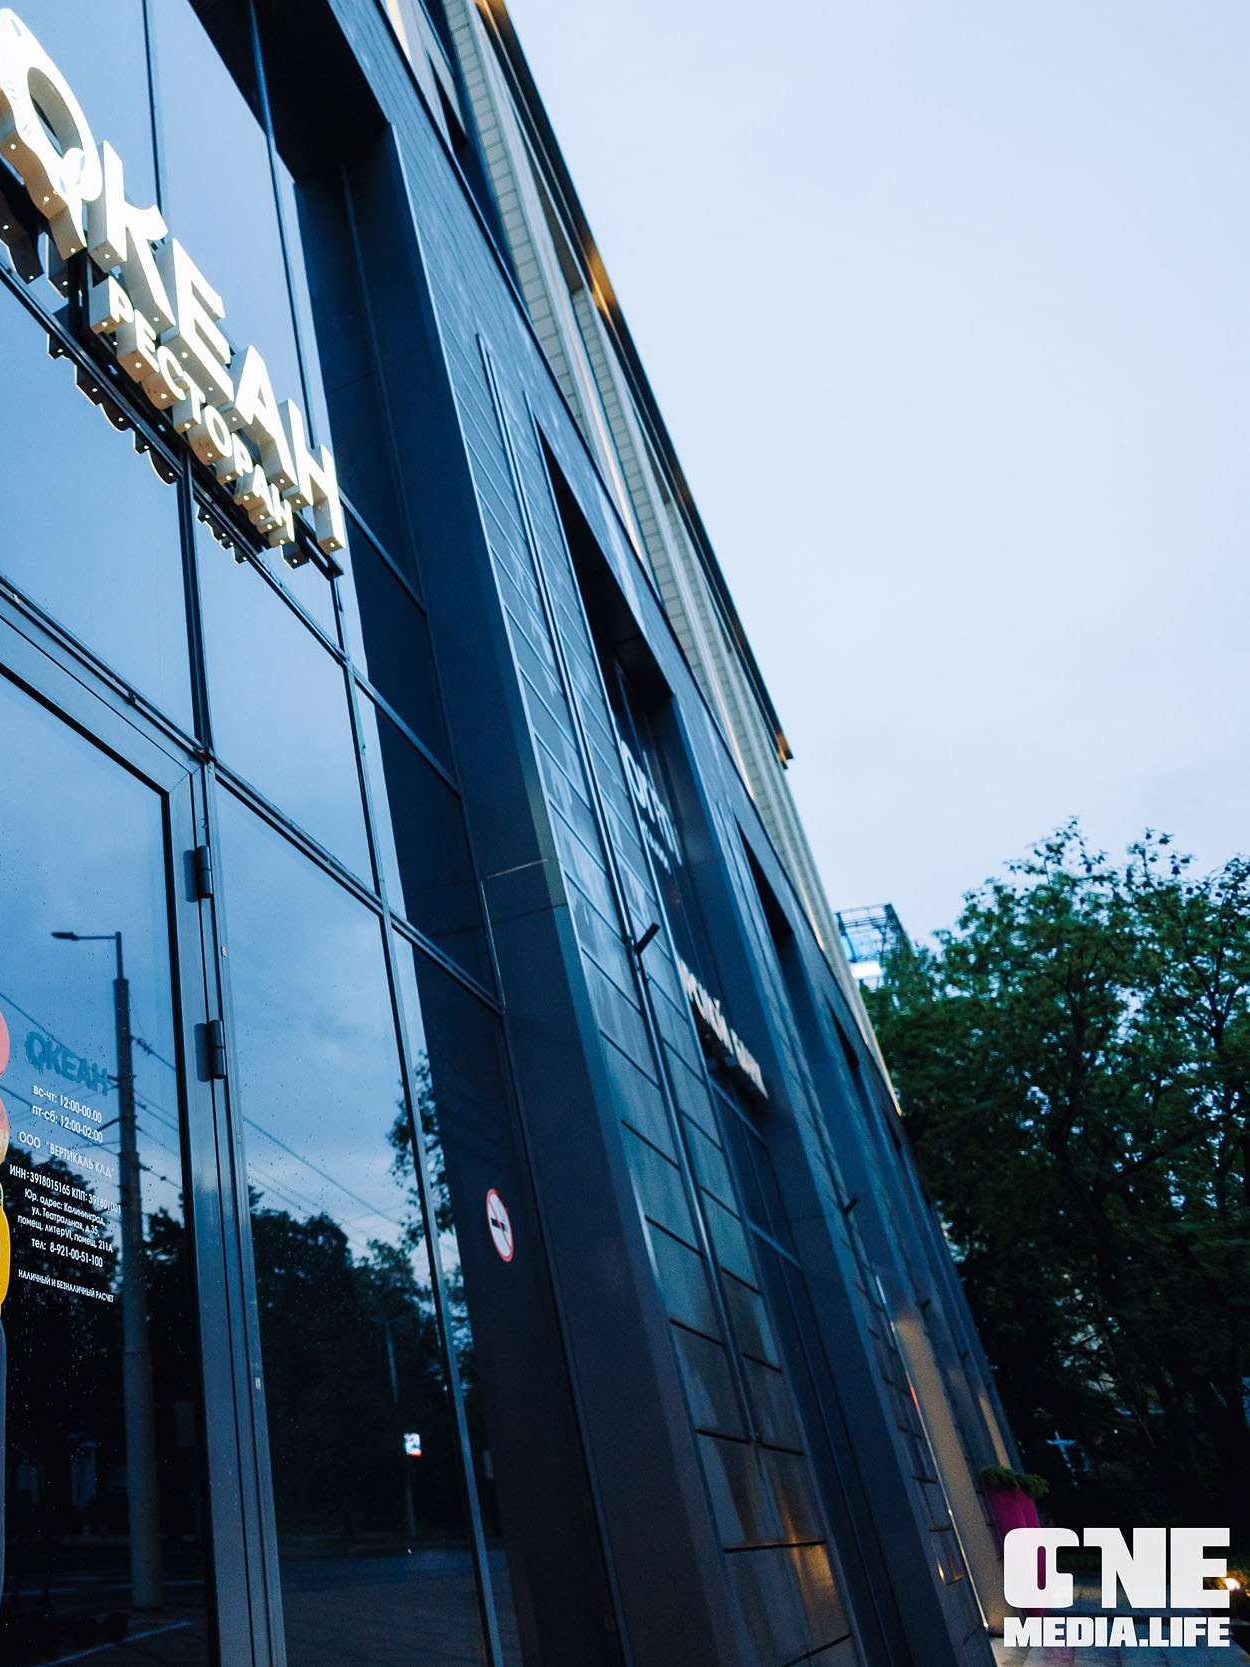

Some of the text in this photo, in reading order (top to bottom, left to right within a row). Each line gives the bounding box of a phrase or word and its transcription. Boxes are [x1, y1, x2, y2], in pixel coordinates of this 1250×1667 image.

[102, 275, 296, 545] РЕСТОРАН
[19, 1131, 41, 1148] ООО
[40, 1195, 63, 1211] адрес:
